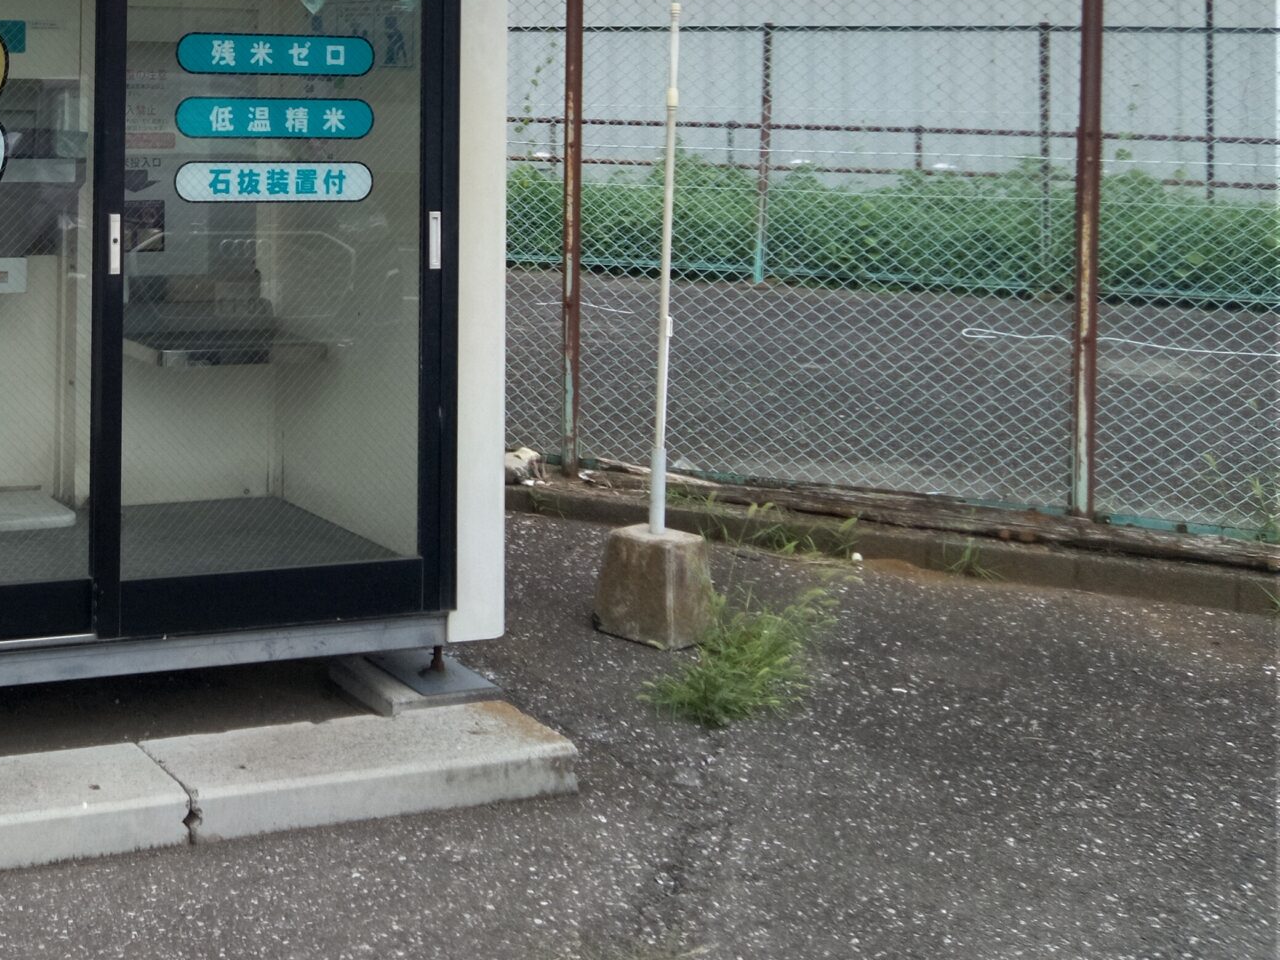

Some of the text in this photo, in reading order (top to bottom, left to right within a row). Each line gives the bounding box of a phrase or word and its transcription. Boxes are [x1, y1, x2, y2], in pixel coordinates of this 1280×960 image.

[211, 41, 346, 67] 残米ゼロ
[209, 106, 346, 133] 低温精米
[208, 169, 347, 195] 石抜装置付
